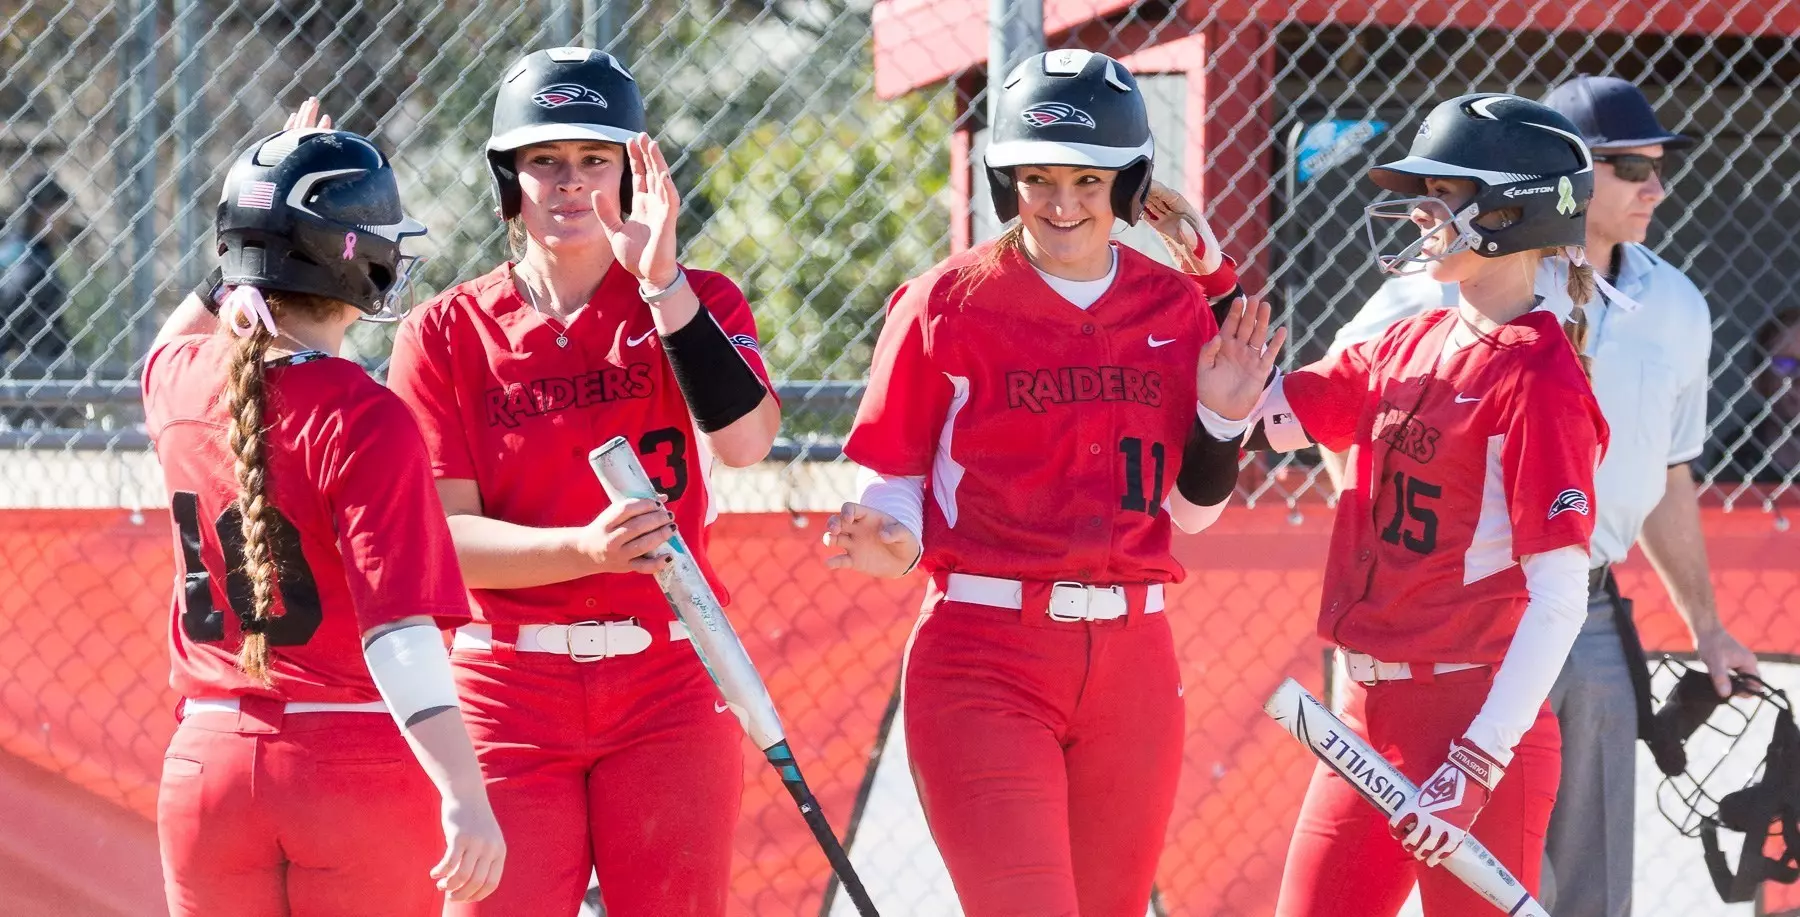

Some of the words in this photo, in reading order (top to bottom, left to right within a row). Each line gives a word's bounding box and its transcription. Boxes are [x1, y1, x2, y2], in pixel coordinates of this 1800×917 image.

[1513, 186, 1555, 197] EASTON
[484, 362, 655, 428] RAIDERS
[1005, 366, 1162, 413] RAIDERS
[1119, 436, 1165, 519] 11
[1380, 471, 1442, 555] 15
[1319, 729, 1407, 813] UISVILLE
[1455, 751, 1488, 777] LOUISVILLE
